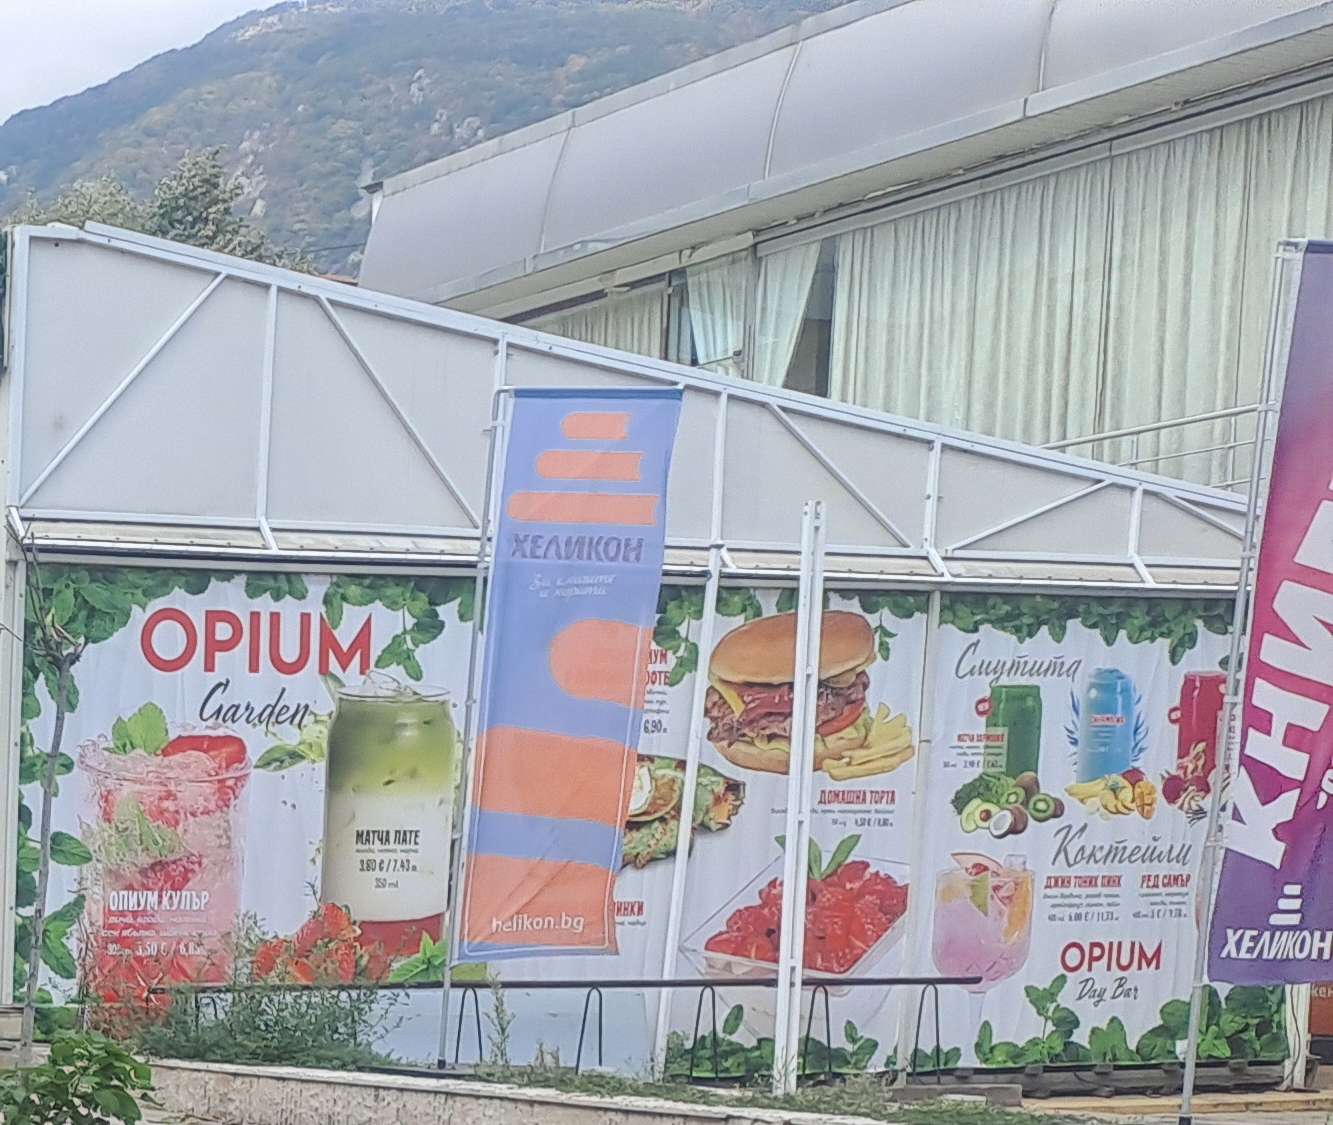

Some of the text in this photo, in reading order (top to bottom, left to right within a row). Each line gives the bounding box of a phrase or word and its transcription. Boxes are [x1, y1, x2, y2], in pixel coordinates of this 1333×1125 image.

[511, 533, 644, 563] ХЕЛИКОН
[140, 607, 372, 676] OPIUM
[954, 638, 1083, 689] Смутита
[199, 678, 310, 731] Garden
[869, 790, 896, 805] ТОРТА
[355, 829, 421, 845] МАТЧА ЛАТЕ
[1051, 822, 1193, 869] Коктейли
[1140, 874, 1160, 889] РЕД
[109, 890, 209, 911] ОПИУМ КУЛЪР
[492, 912, 585, 934] helikon.bg
[1061, 940, 1162, 972] OPIUM
[1220, 928, 1333, 959] ХЕЛИКОН
[1076, 976, 1139, 1007] Day Bar
